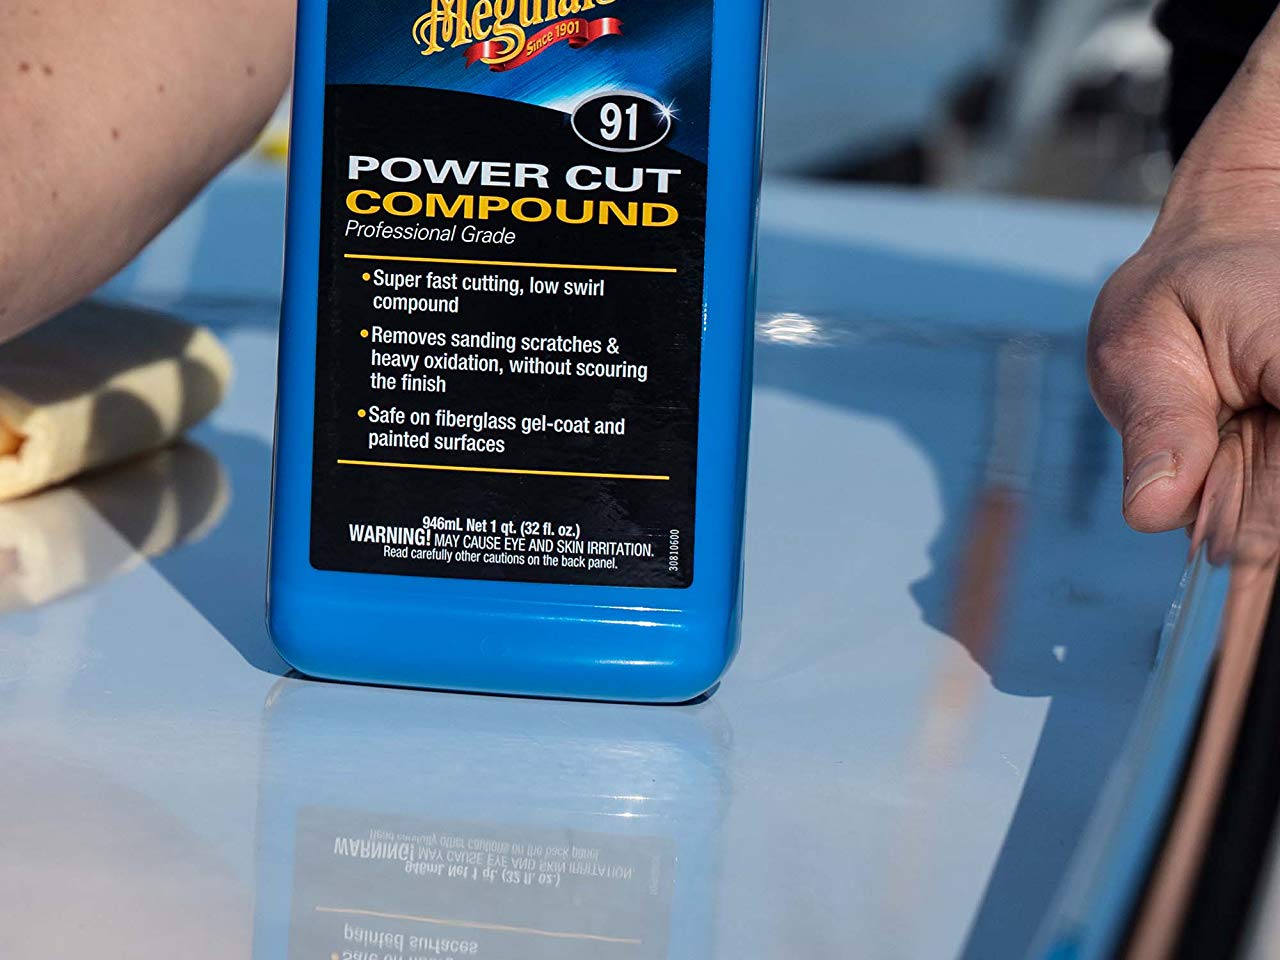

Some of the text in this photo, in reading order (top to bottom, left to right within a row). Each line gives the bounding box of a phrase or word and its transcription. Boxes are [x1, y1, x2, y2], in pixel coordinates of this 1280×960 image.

[526, 20, 580, 57] Since 1901
[600, 103, 638, 141] 91
[348, 155, 681, 193] POWER CUT
[345, 189, 679, 227] COMPOUND
[345, 220, 516, 245] Professional Grade
[373, 269, 605, 296] Super fast cutting, low swirl
[373, 294, 459, 315] compound
[372, 327, 620, 354] Removes sanding scratches &
[371, 349, 648, 382] heavy oxidation, without scouring
[370, 373, 446, 393] the finish
[369, 406, 625, 435] Safe on fiberglass gel-coat and
[368, 429, 505, 452] painted surfaces
[349, 523, 654, 557] WARNING! MAY CAUSE EYE AND SKIN IRRITATION.
[422, 516, 581, 538] 946mL Net 1 qt. (32 fl. oz.)
[384, 545, 618, 569] Read carefully other cautions on the back panel.
[669, 529, 680, 572] 30810600
